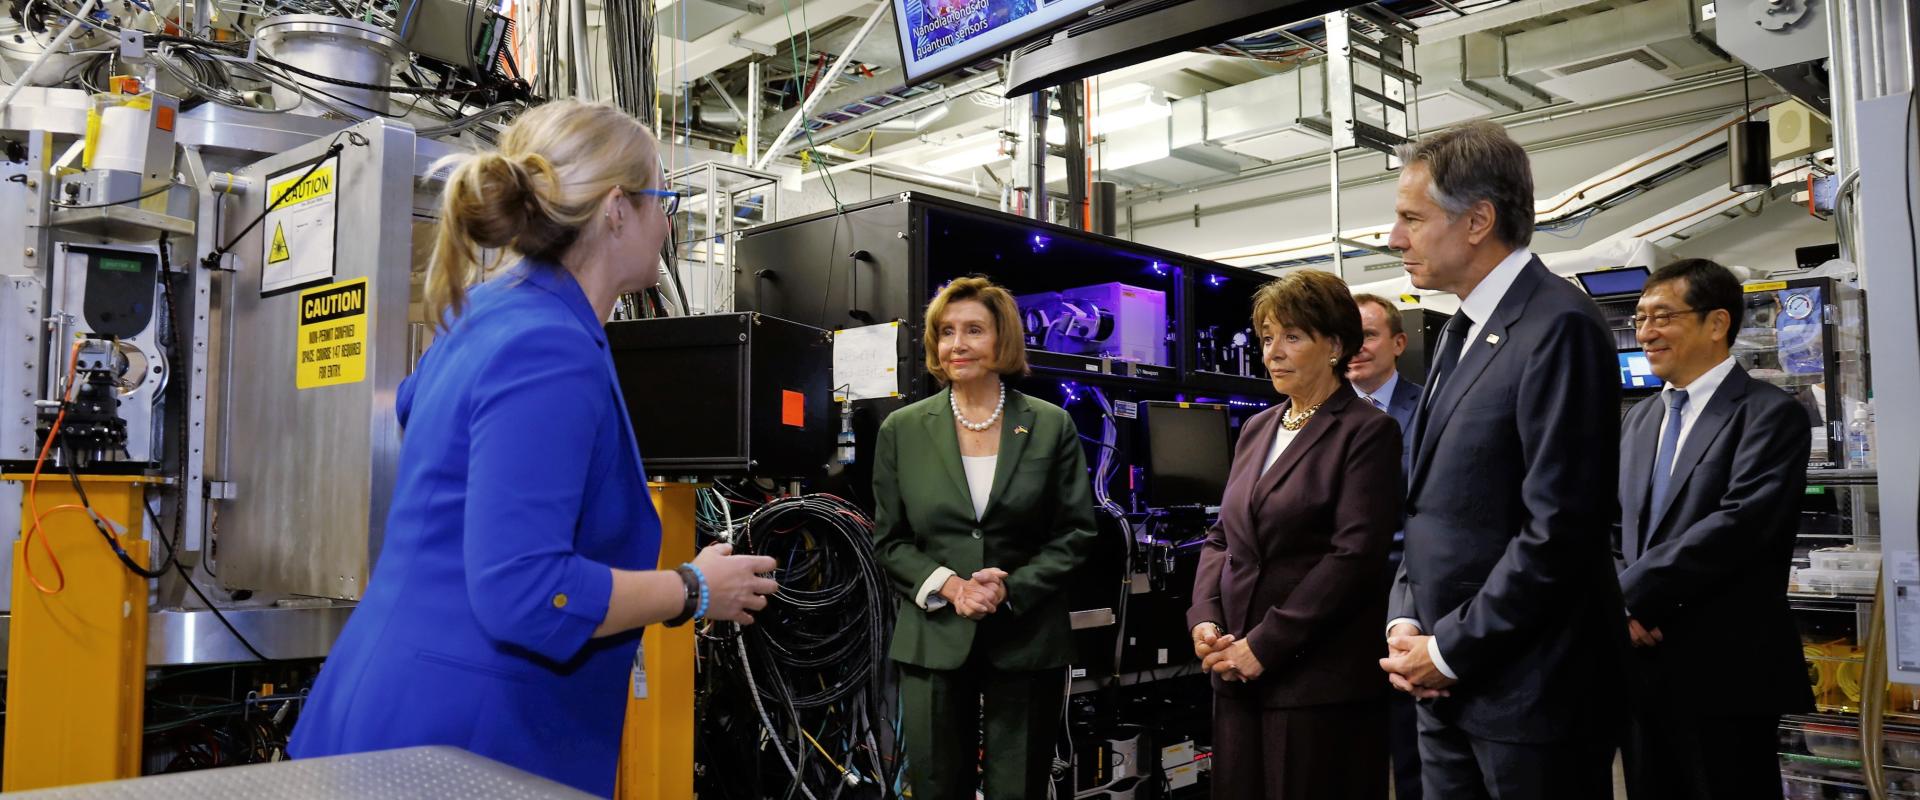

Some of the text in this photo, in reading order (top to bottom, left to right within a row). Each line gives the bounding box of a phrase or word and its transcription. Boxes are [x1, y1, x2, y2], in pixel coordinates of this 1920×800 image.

[912, 2, 976, 38] Nanodiamonds
[916, 19, 989, 59] quantum sensors
[284, 174, 329, 202] CAUTION
[305, 289, 361, 319] CAUTION
[302, 349, 315, 364] SPACE
[341, 341, 362, 358] REQUIRED
[319, 366, 327, 379] FOR
